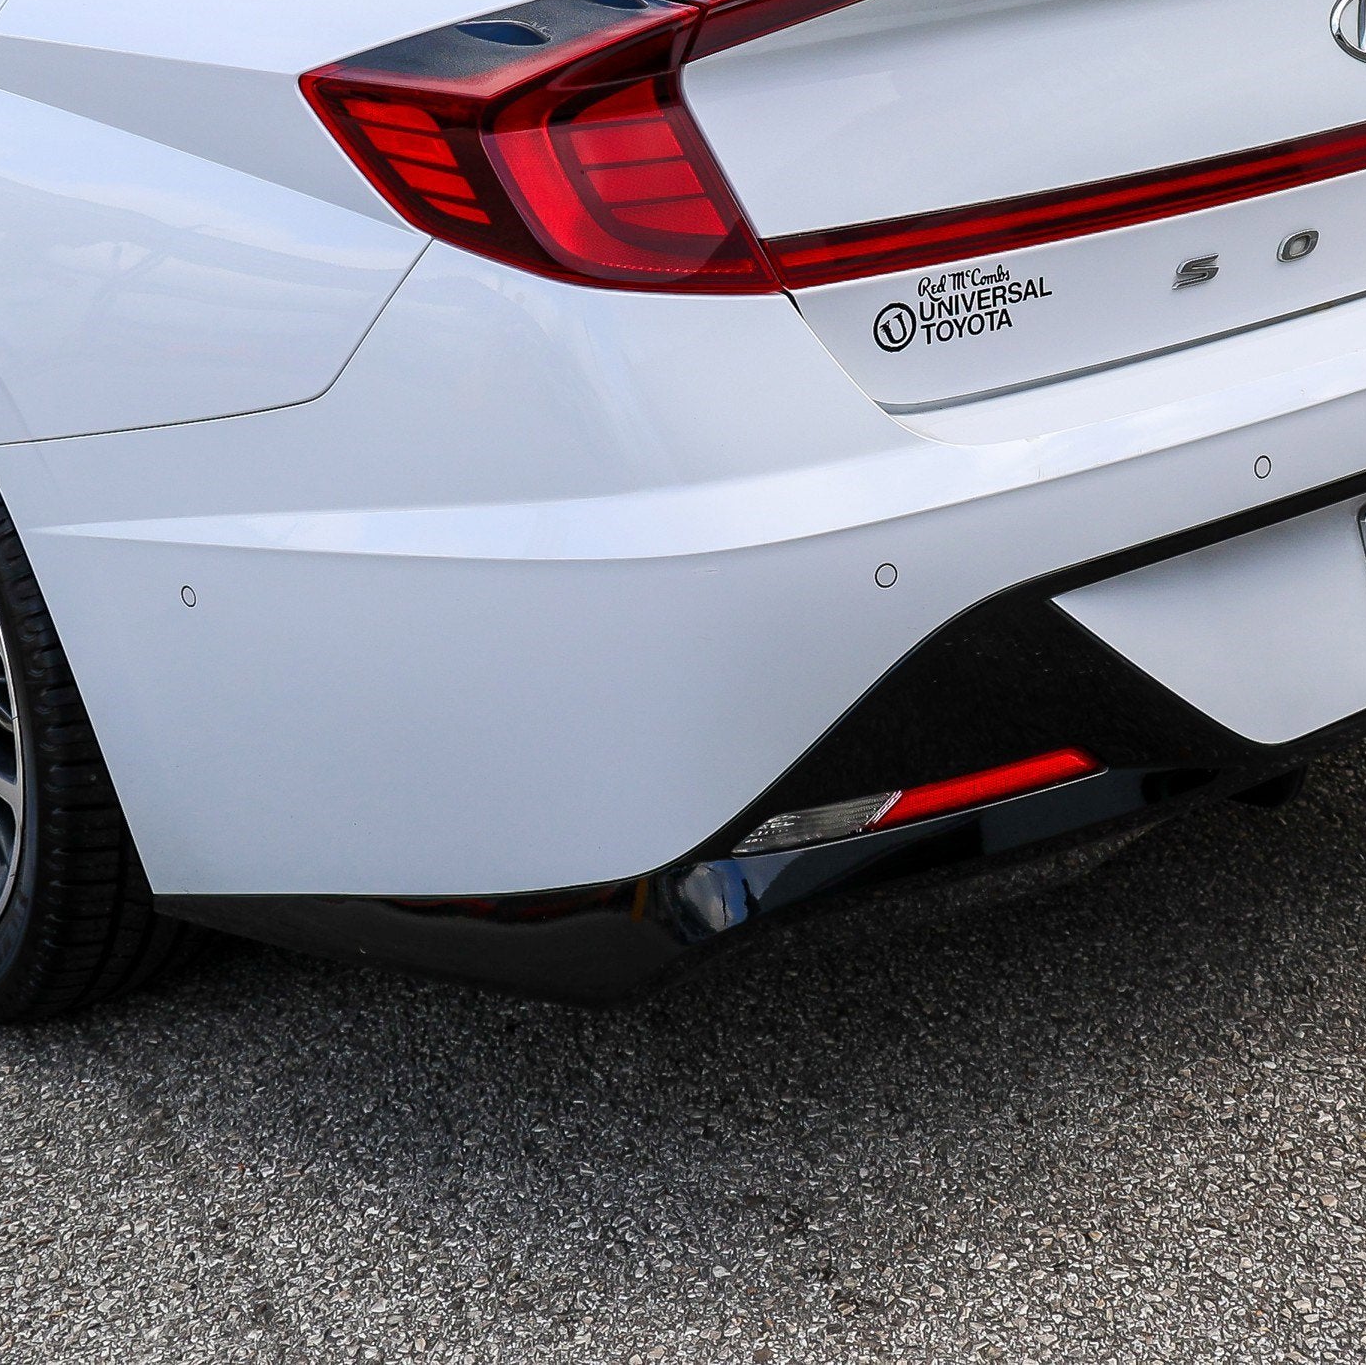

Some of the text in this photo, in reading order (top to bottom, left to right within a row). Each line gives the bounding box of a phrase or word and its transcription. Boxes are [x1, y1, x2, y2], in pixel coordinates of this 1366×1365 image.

[917, 264, 1010, 302] Red McCombs
[919, 277, 1053, 322] UNIVERSAL
[921, 308, 1013, 345] TOYOTA
